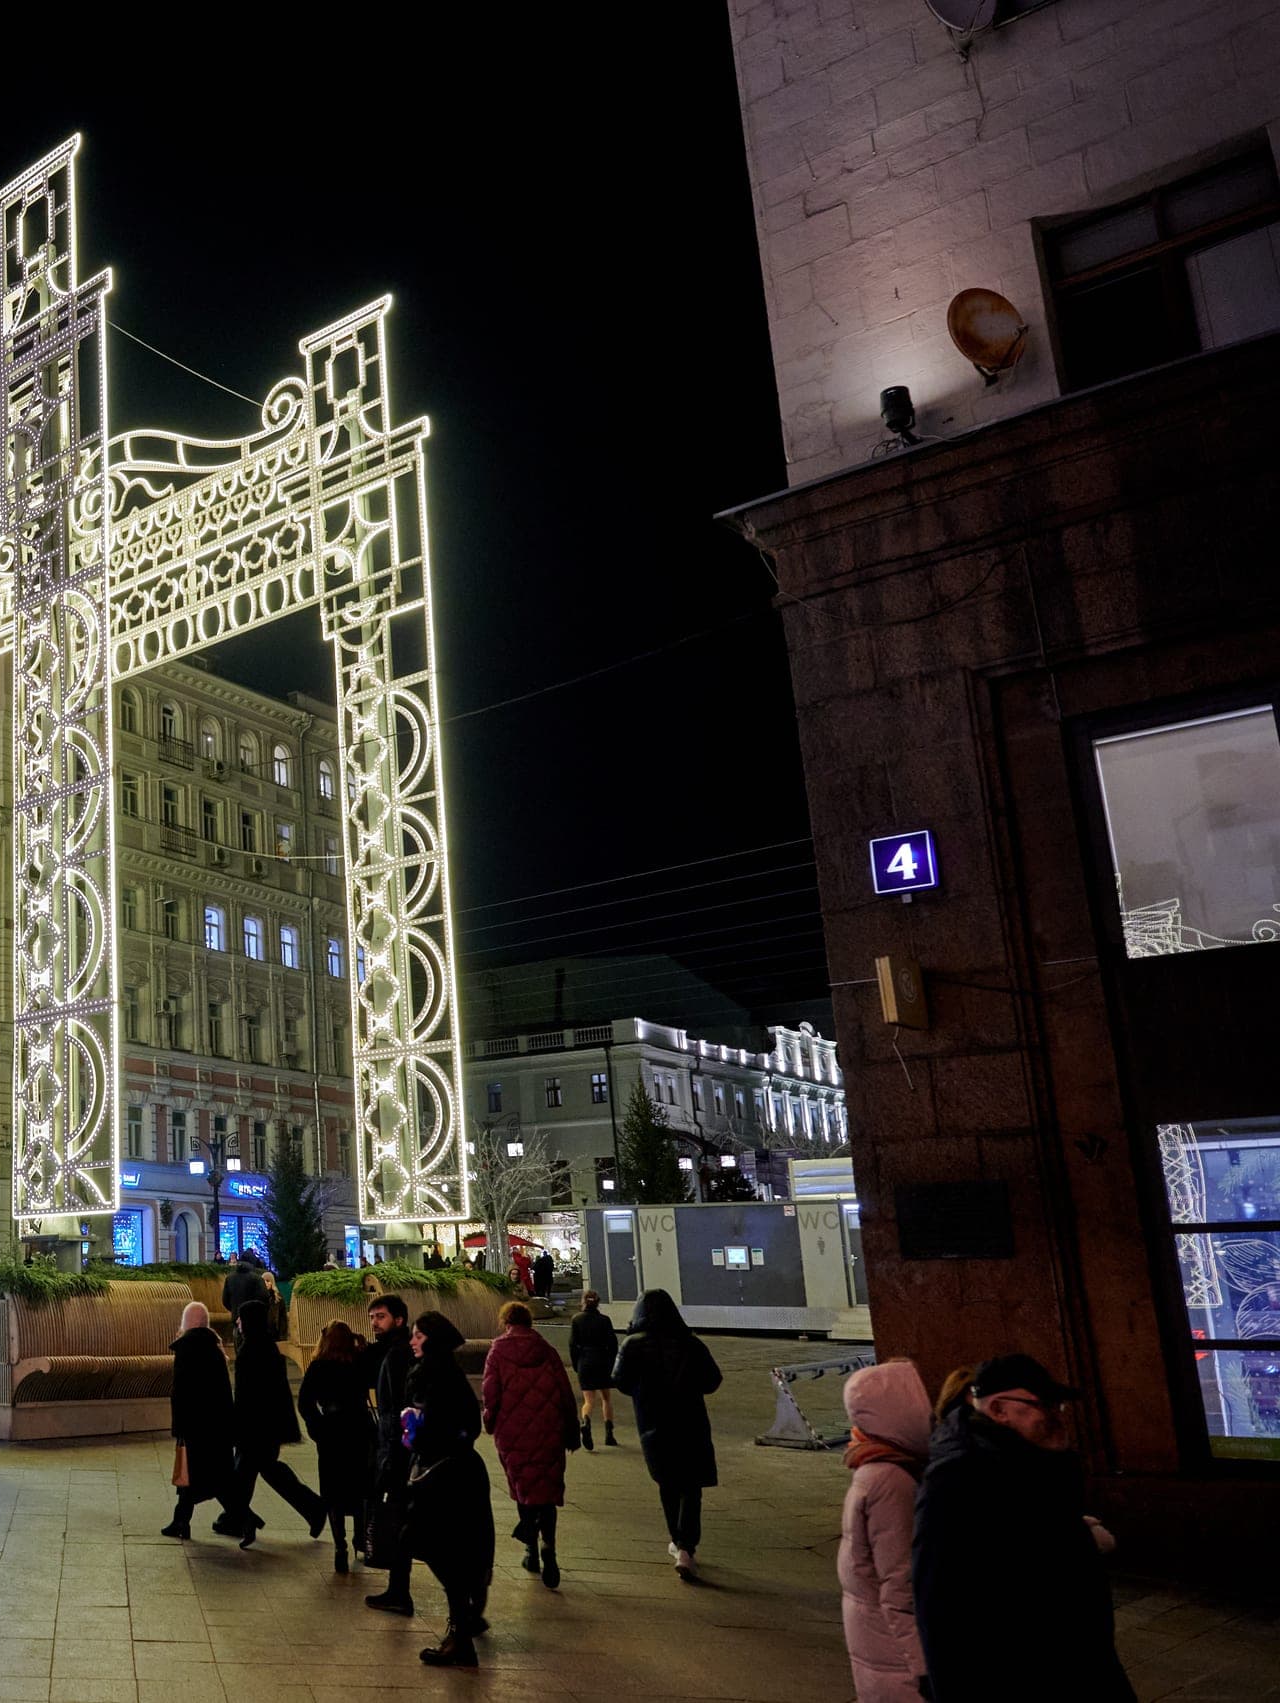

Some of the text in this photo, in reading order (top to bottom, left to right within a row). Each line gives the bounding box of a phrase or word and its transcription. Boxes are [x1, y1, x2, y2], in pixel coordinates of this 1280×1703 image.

[886, 843, 918, 879] 4
[639, 1215, 674, 1232] WC
[799, 1211, 839, 1230] WC
